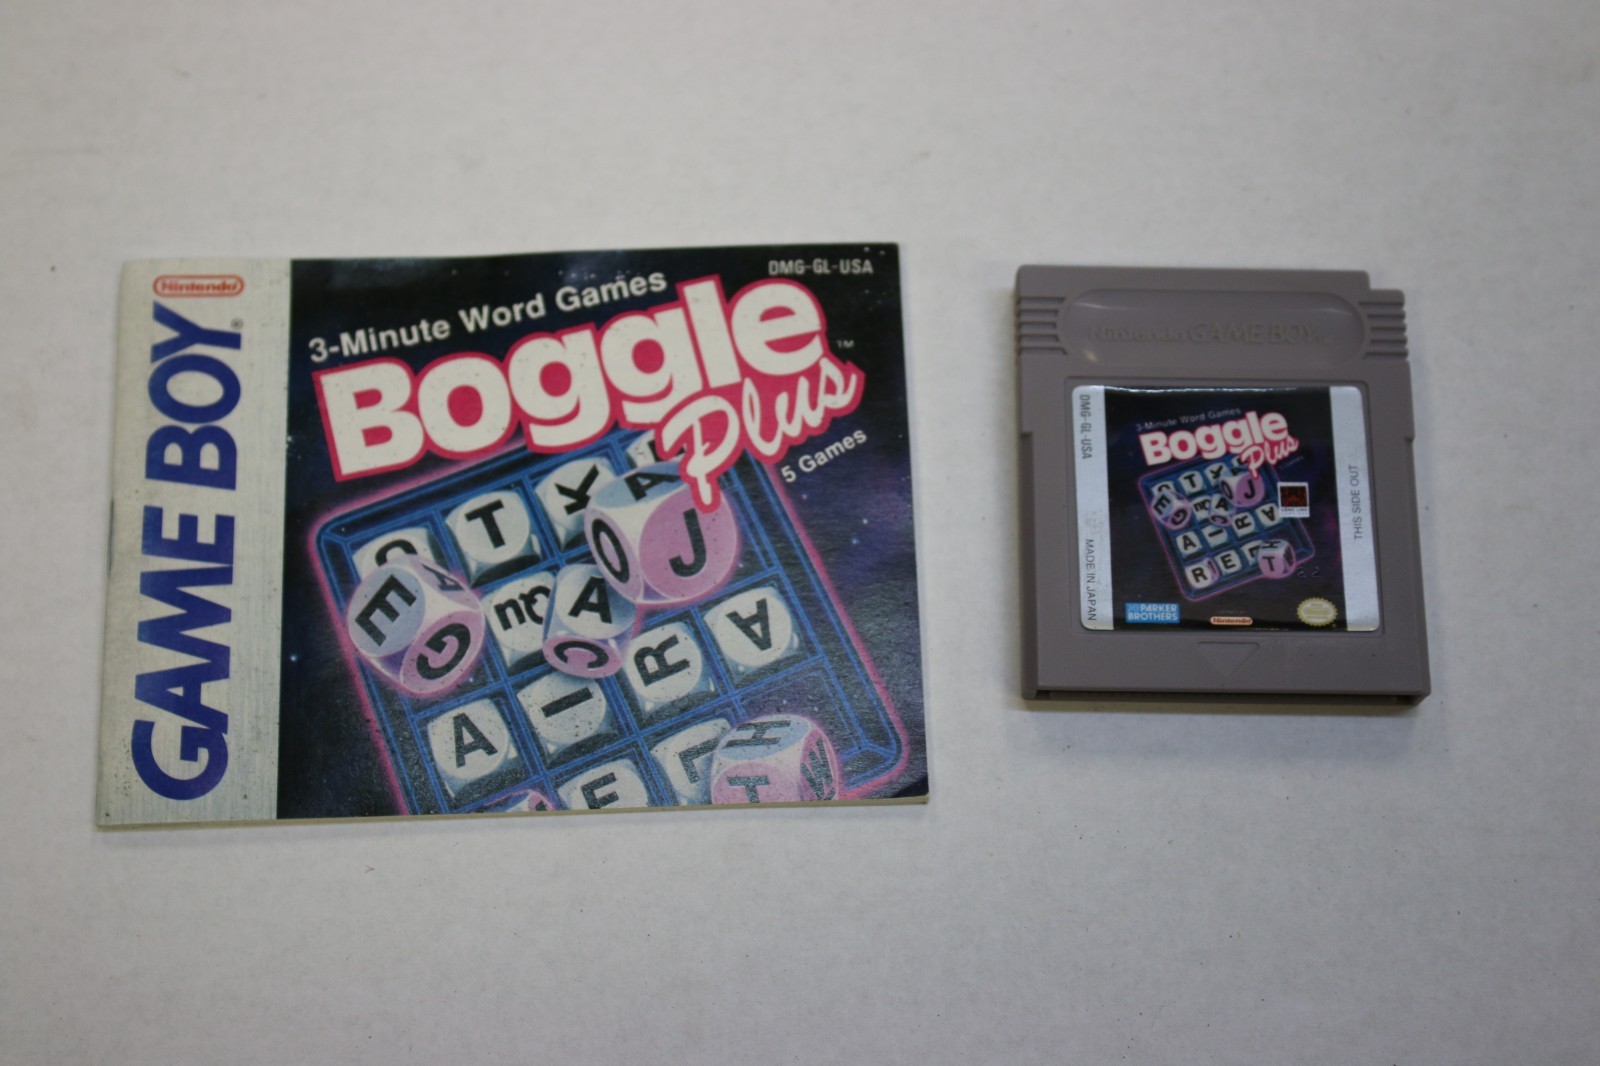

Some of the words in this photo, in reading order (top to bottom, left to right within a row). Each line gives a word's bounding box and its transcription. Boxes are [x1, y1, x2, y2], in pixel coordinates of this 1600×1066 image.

[768, 257, 874, 276] DMG-GL-USA
[160, 280, 239, 293] Nintendo
[308, 319, 451, 363] 3-Minute
[458, 293, 546, 333] Word
[555, 271, 668, 312] Games
[1189, 320, 1263, 344] GAME
[1268, 320, 1315, 345] BOY
[315, 276, 825, 481] Boggle
[145, 299, 241, 491] BOY
[1079, 394, 1093, 460] DMG-GL-USA
[1179, 413, 1206, 424] Word
[1207, 407, 1242, 419] Games
[658, 356, 862, 509] Plus
[1139, 410, 1289, 466] Boggle
[780, 464, 797, 484] 5
[797, 428, 868, 474] Games
[1240, 434, 1299, 479] Plus
[554, 463, 600, 516] K
[1183, 473, 1197, 489] T
[1243, 479, 1256, 500] J
[1348, 464, 1360, 487] OUT
[1152, 494, 1171, 516] E
[1261, 505, 1276, 522] A
[1350, 489, 1362, 514] SIDE
[464, 498, 506, 550] T
[1234, 515, 1252, 531] R
[1352, 516, 1364, 540] THIS
[669, 507, 707, 579] J
[1085, 539, 1096, 571] MADE
[1181, 534, 1197, 551] A
[1190, 566, 1208, 584] R
[1219, 553, 1237, 570] E
[1261, 555, 1276, 572] T
[1086, 573, 1096, 584] IN
[354, 573, 417, 648] E
[567, 575, 613, 625] A
[1087, 586, 1097, 621] JAPAN
[1140, 603, 1177, 612] PARKER
[725, 597, 773, 652] A
[1127, 612, 1178, 621] BROTHERS
[1213, 616, 1252, 624] Nintendo
[131, 505, 234, 800] GAME
[416, 622, 472, 681] G
[553, 640, 610, 670] C
[632, 634, 691, 688] R
[452, 711, 499, 769] A
